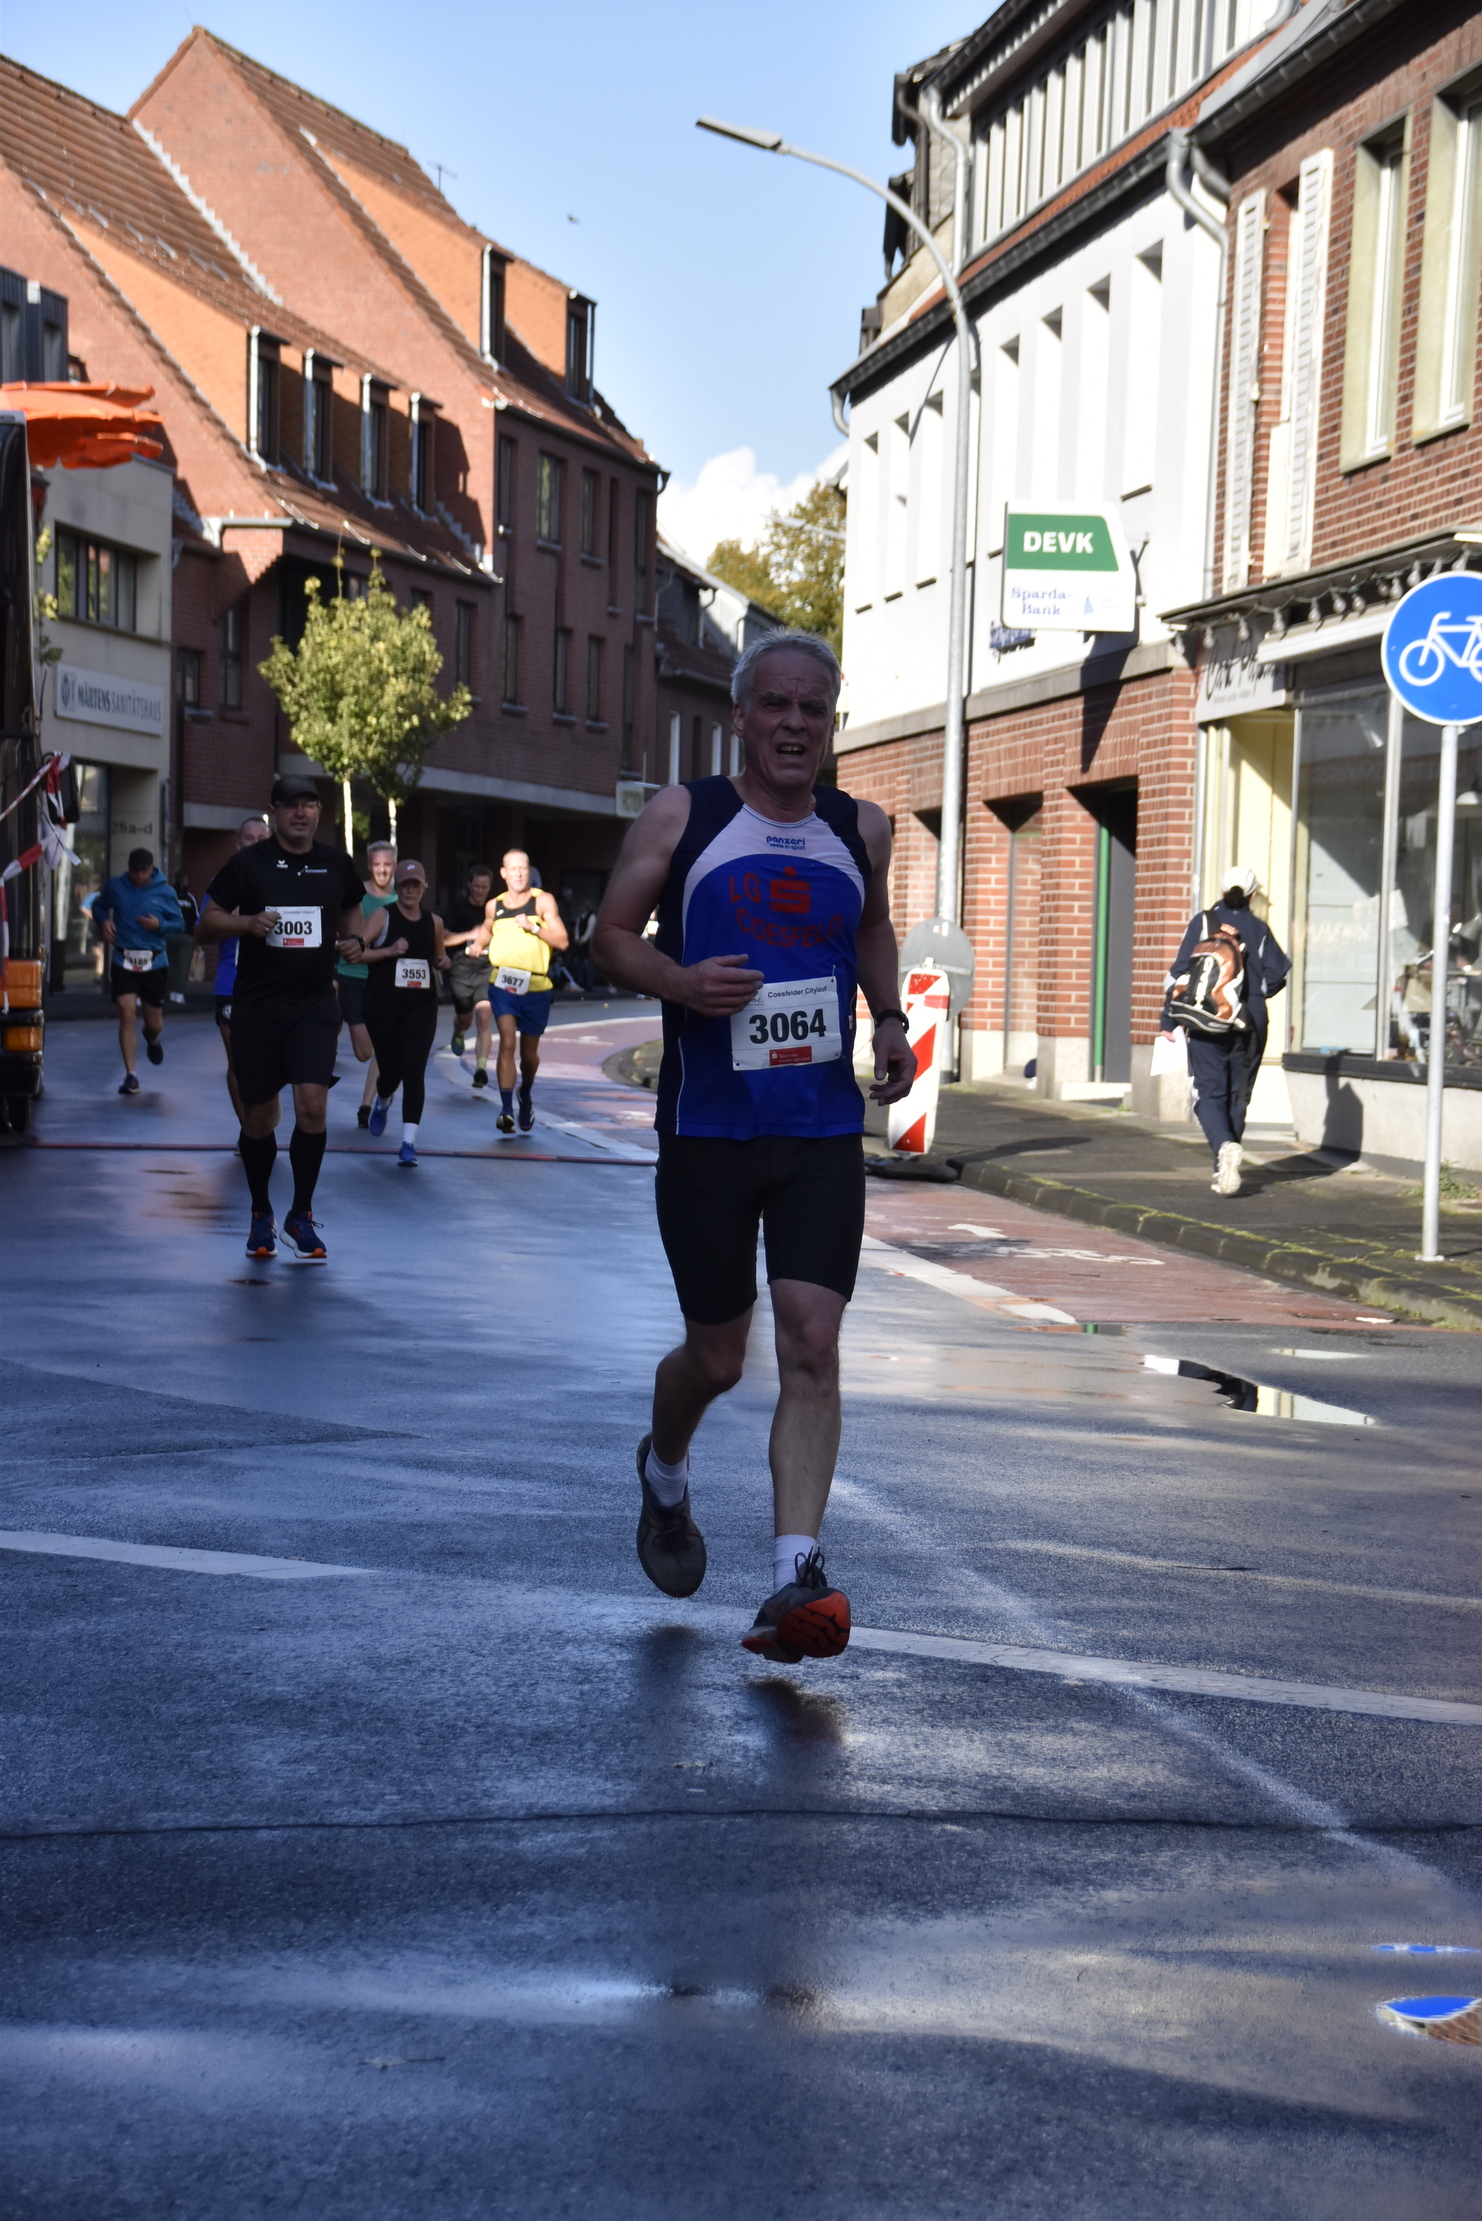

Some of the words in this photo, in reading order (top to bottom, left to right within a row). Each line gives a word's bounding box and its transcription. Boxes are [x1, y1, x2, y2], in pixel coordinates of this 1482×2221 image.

[1023, 531, 1094, 554] DEVK
[1022, 602, 1061, 616] Bank
[766, 836, 805, 846] panzeri
[729, 872, 761, 904] LG
[274, 921, 313, 935] 3003
[736, 907, 842, 948] COESFELD
[402, 968, 426, 980] 3553
[501, 974, 525, 987] 3677
[767, 988, 804, 998] Coesfelder
[804, 985, 828, 995] Citylauf
[748, 1008, 827, 1045] 3064
